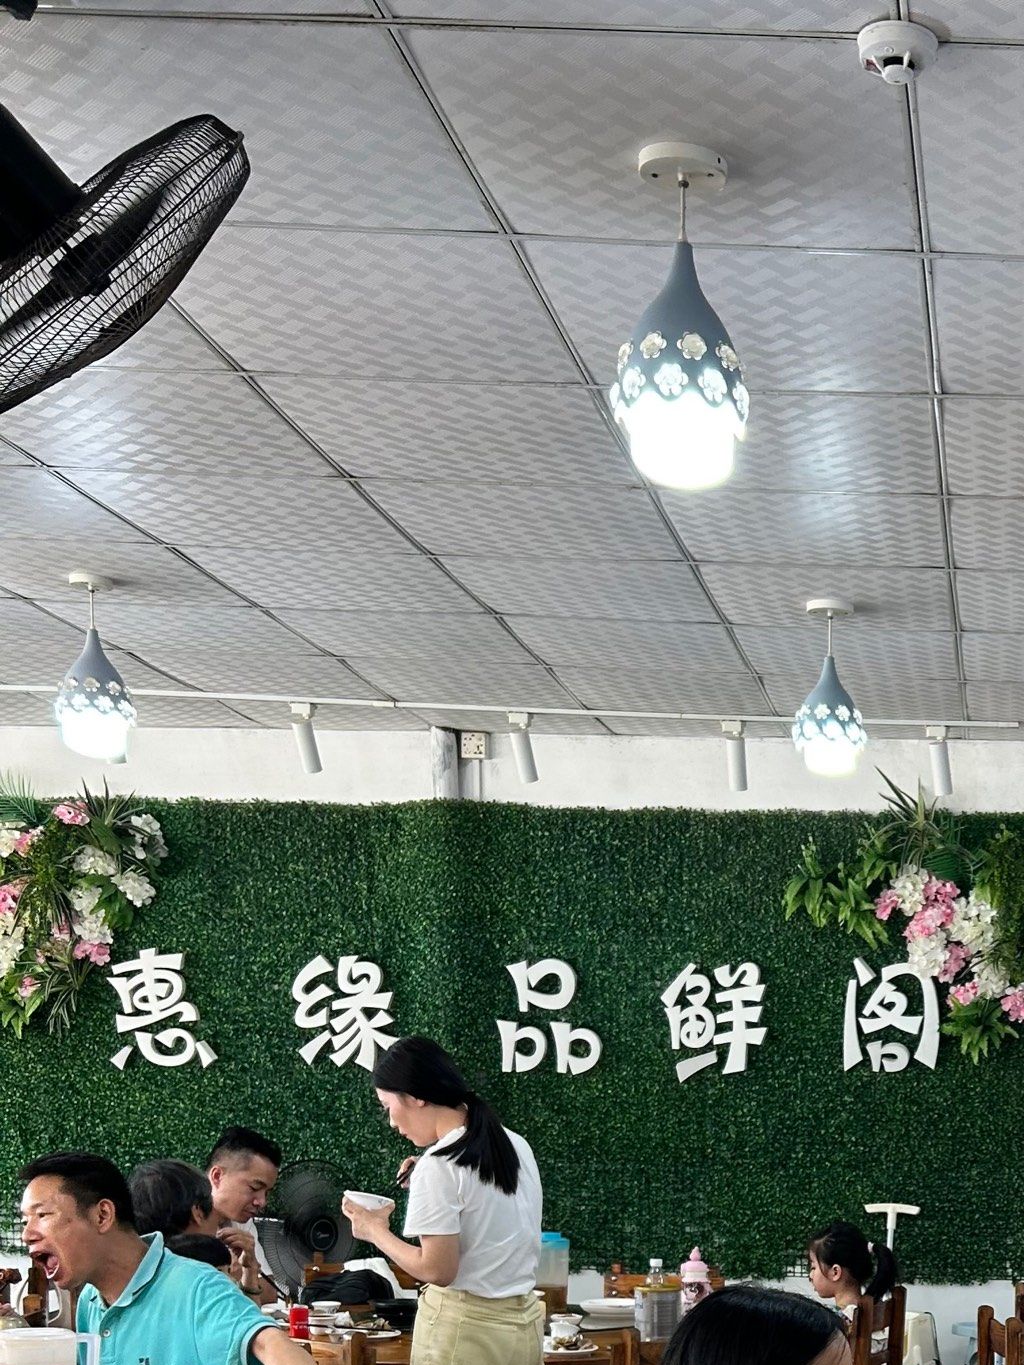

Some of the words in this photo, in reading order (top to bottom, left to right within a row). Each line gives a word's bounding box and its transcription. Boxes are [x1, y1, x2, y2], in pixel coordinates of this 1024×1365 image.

[109, 947, 940, 1083] 惠缘品鲜阁
